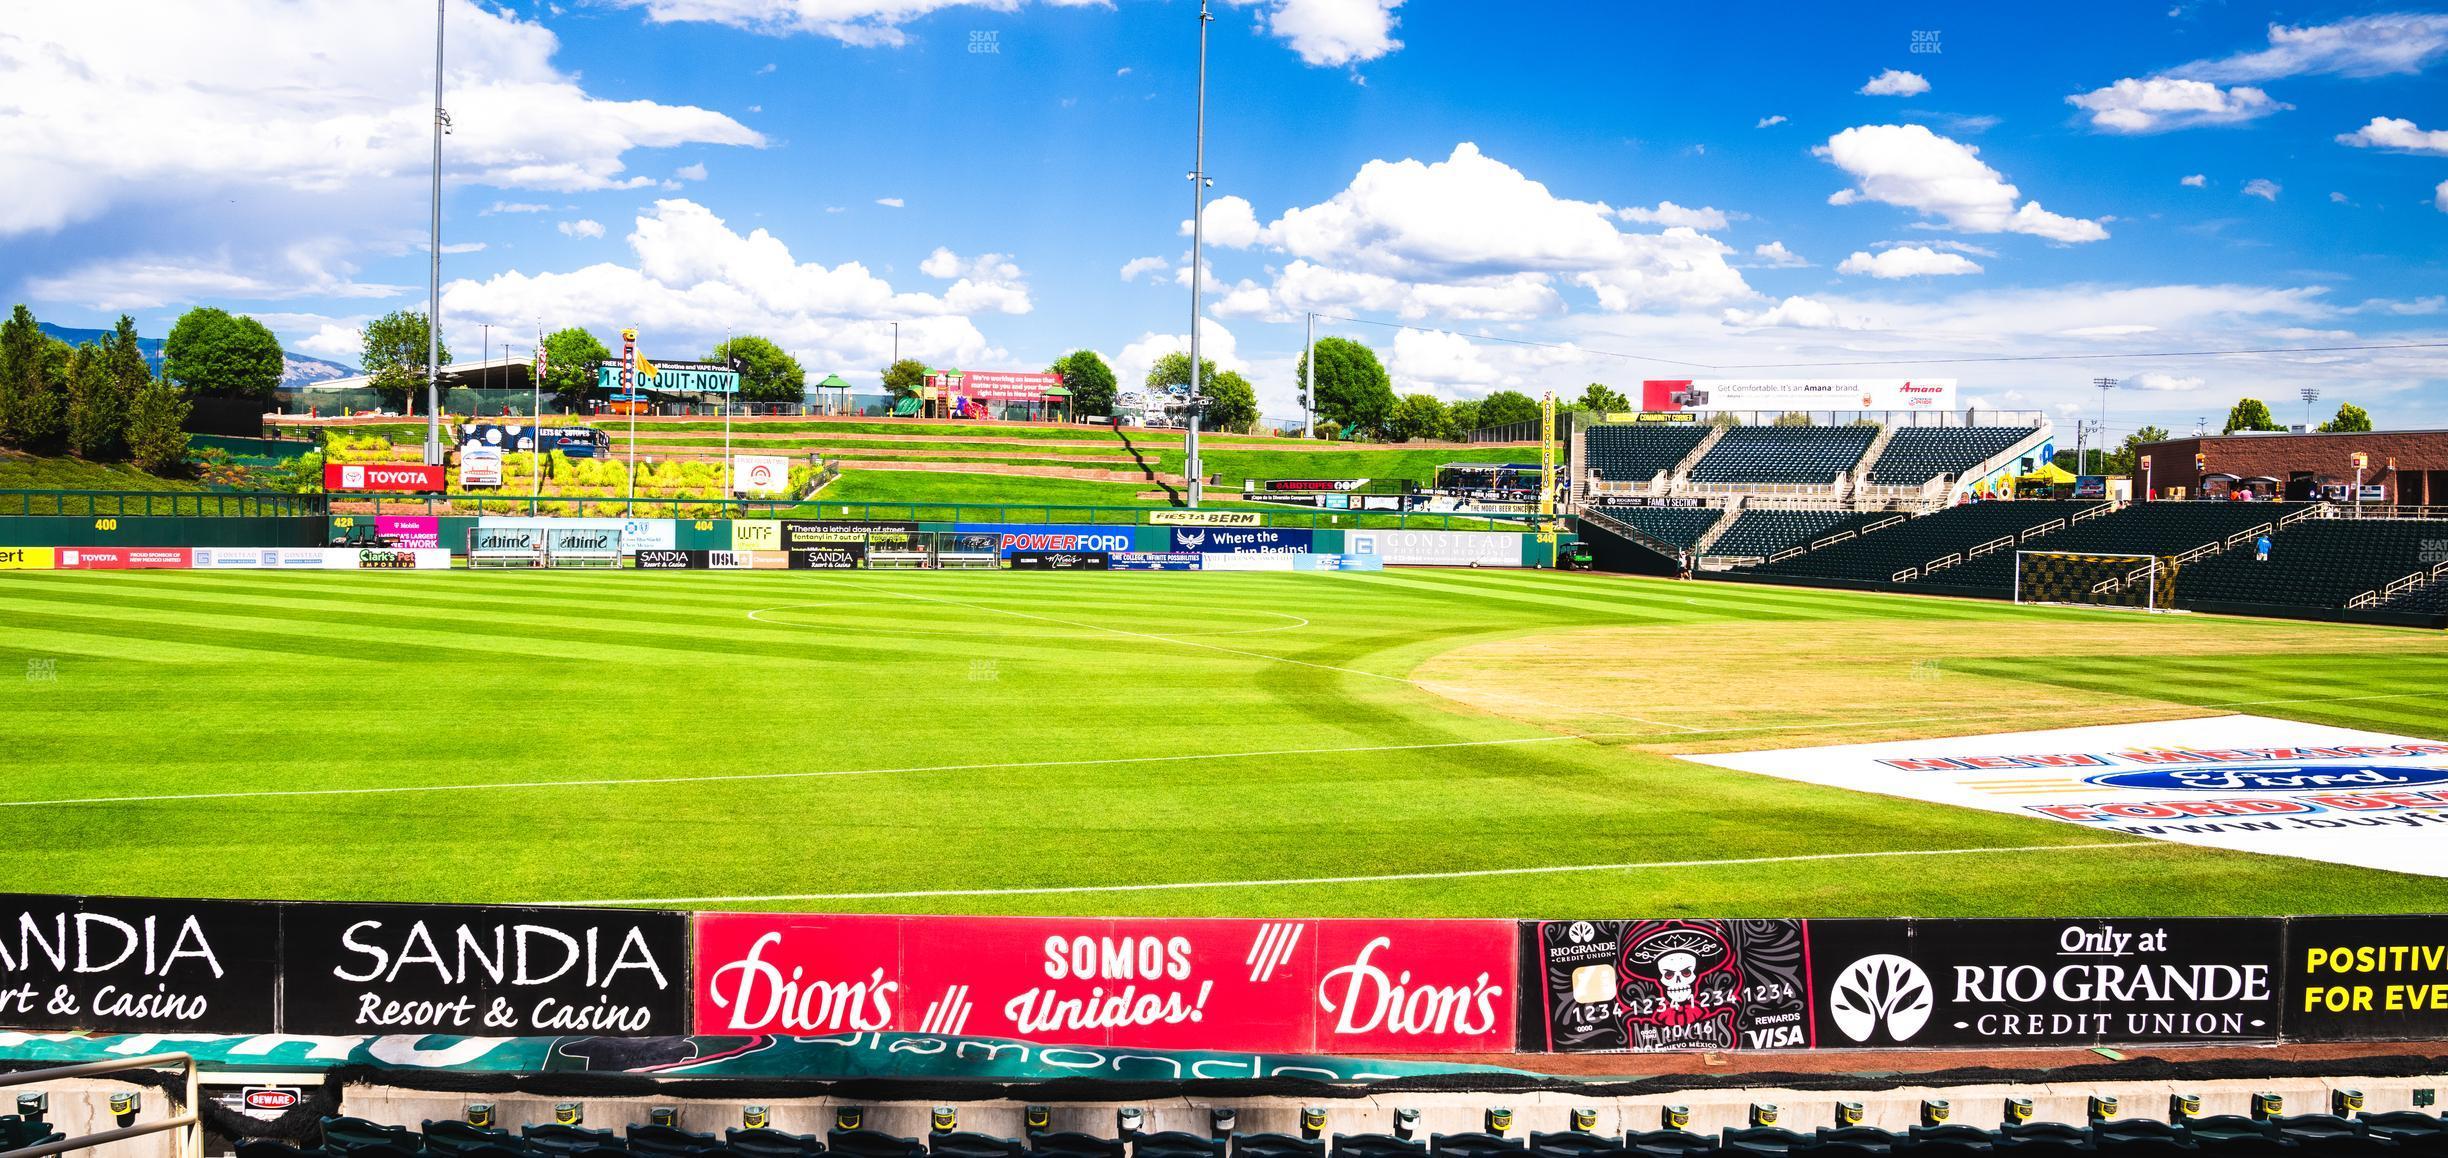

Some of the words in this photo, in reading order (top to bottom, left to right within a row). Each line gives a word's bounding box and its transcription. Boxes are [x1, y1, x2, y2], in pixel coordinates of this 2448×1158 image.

[972, 374, 990, 382] We're
[1718, 384, 1730, 392] Get
[1732, 384, 1779, 392] Comfortable.
[1780, 384, 1792, 392] It's
[1804, 384, 1832, 392] Amana
[1835, 384, 1860, 392] brand.
[1900, 381, 1943, 393] Amana
[1640, 414, 1671, 422] COMMUNITY
[1672, 414, 1694, 422] CORNER
[540, 428, 554, 436] LETS
[368, 471, 428, 484] TOYOTA
[1470, 504, 1480, 512] THE
[1481, 504, 1498, 512] MODEL
[1498, 504, 1512, 512] BEER
[1512, 505, 1528, 513] SINCE
[1648, 498, 1670, 507] FAMILY
[1672, 498, 1698, 507] SECTION
[95, 518, 118, 530] 400
[1208, 514, 1254, 523] BERM
[694, 520, 713, 531] 404
[738, 526, 772, 540] WTF
[794, 534, 825, 542] fentanyl
[1213, 532, 1254, 545] Where
[1256, 532, 1278, 542] the
[1536, 534, 1554, 544] 340
[1387, 534, 1513, 549] GONSTEAD
[360, 548, 396, 562] Clark's
[397, 552, 416, 561] Pet
[1235, 546, 1257, 554] Fun
[1260, 544, 1308, 554] Begins!
[81, 554, 118, 562] TOYOTA
[640, 552, 689, 562] SANDIA
[712, 552, 738, 566] USL
[808, 552, 853, 562] SANDIA
[1123, 554, 1145, 562] COLLEGE,
[1878, 754, 2110, 771] NEW
[2170, 767, 2408, 789] Ford
[2026, 798, 2320, 821] FORD
[2060, 926, 2132, 957] Only
[2138, 928, 2167, 952] at
[333, 919, 669, 990] SANDIA
[1044, 934, 1192, 982] SOMOS
[1556, 954, 1584, 962] CREDIT
[1586, 952, 1612, 960] UNION
[2306, 945, 2448, 974] POSITIV
[710, 932, 898, 1031] Dion's
[1318, 936, 1502, 1036] Dion's
[2052, 964, 2271, 1002] GRANDE
[46, 984, 80, 1015] &
[92, 985, 208, 1020] Casino
[1572, 1002, 1624, 1022] 1234
[1630, 996, 1681, 1016] 1234
[1688, 990, 1736, 1009] 1234
[1744, 982, 1794, 1002] 1234
[2305, 985, 2376, 1013] FOR
[356, 992, 475, 1026] Resort
[484, 998, 518, 1028] &
[532, 996, 651, 1032] Casino
[1004, 980, 1212, 1035] Unidos!
[1755, 1012, 1800, 1025] REWARDS
[1977, 1013, 2112, 1036] CREDIT
[2128, 1012, 2244, 1034] UNION
[1577, 1024, 1594, 1032] 0000
[1662, 1021, 1712, 1038] 10/16
[1688, 1040, 1718, 1048] MÉXICO
[1745, 1026, 1804, 1049] VISA
[252, 1095, 290, 1105] BEWARE
